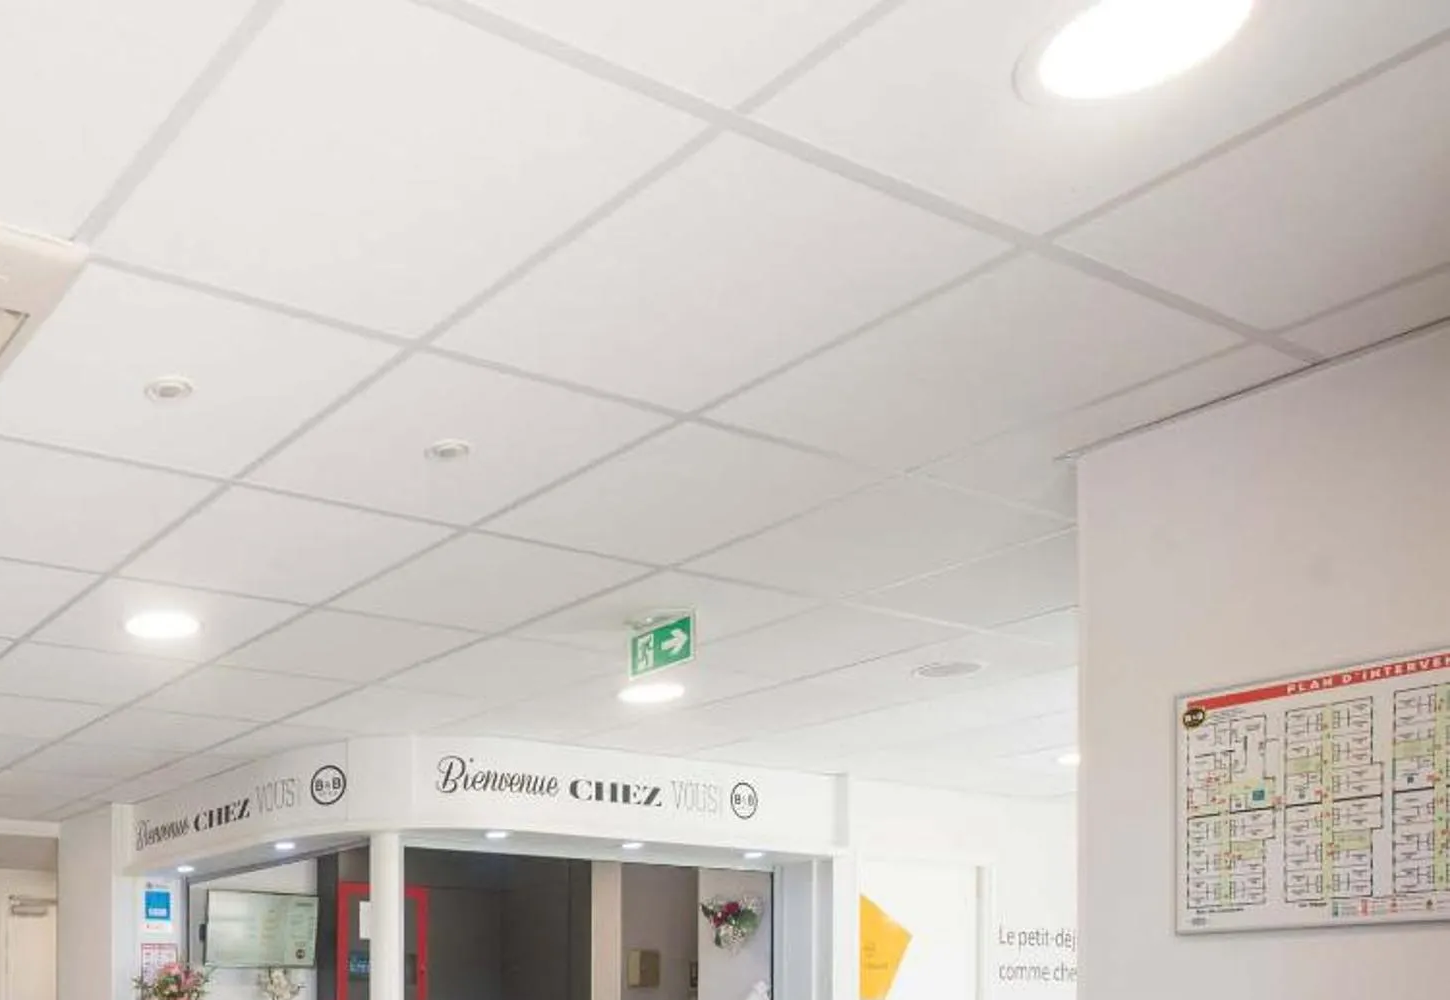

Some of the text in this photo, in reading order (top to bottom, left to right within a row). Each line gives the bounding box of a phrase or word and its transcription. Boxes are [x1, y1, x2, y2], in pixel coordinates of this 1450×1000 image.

[1286, 675, 1334, 695] PLAN
[436, 755, 560, 798] Bienvenue
[569, 779, 663, 808] CHEZ
[193, 797, 251, 832] CHEZ
[999, 924, 1015, 946] Le
[999, 964, 1051, 982] comme
